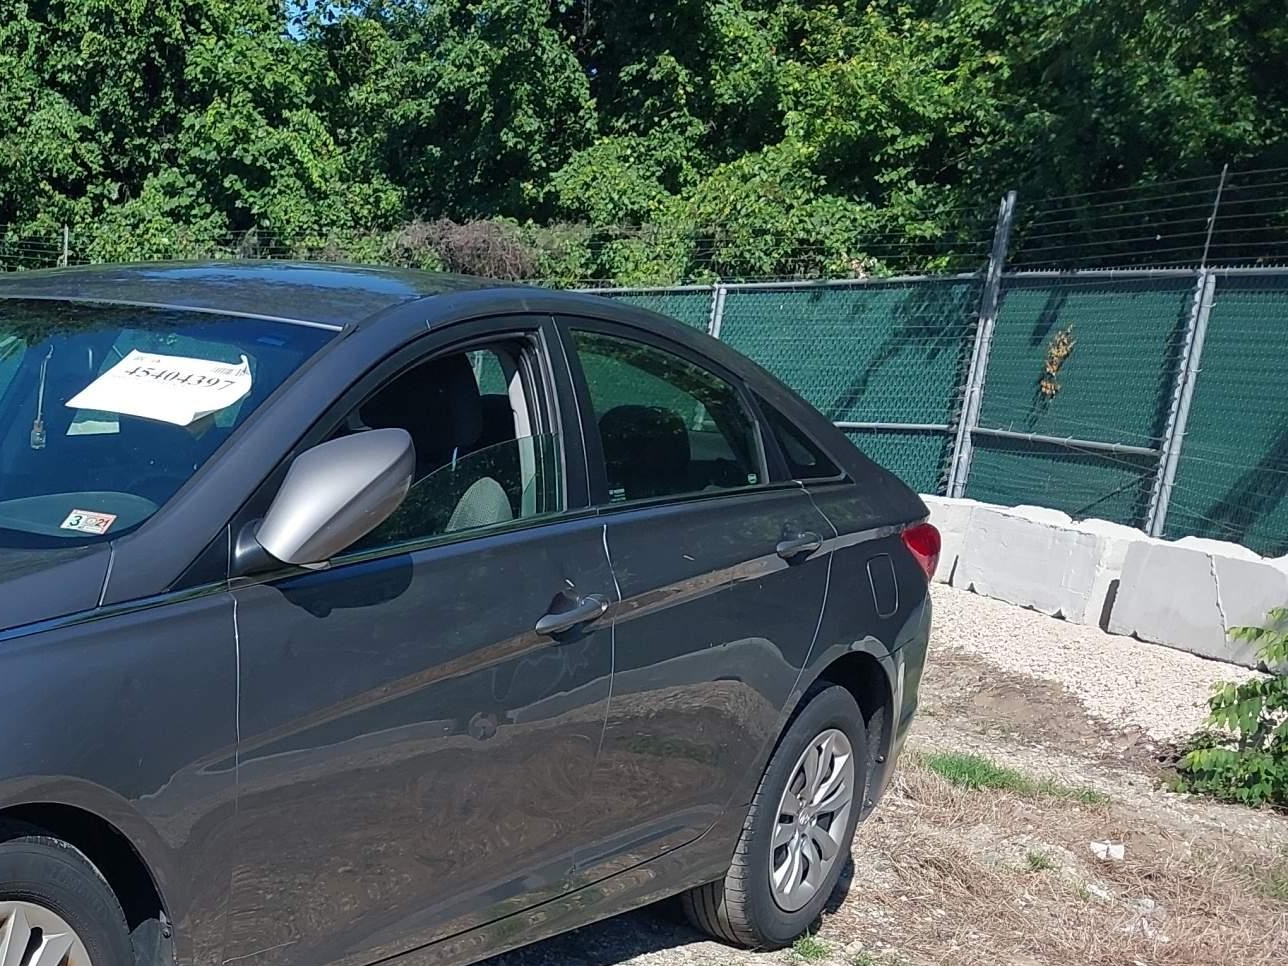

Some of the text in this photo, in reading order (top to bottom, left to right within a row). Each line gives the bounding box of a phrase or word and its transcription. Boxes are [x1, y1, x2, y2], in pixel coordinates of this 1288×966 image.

[125, 366, 236, 390] 45404397
[69, 515, 110, 528] 3 21
